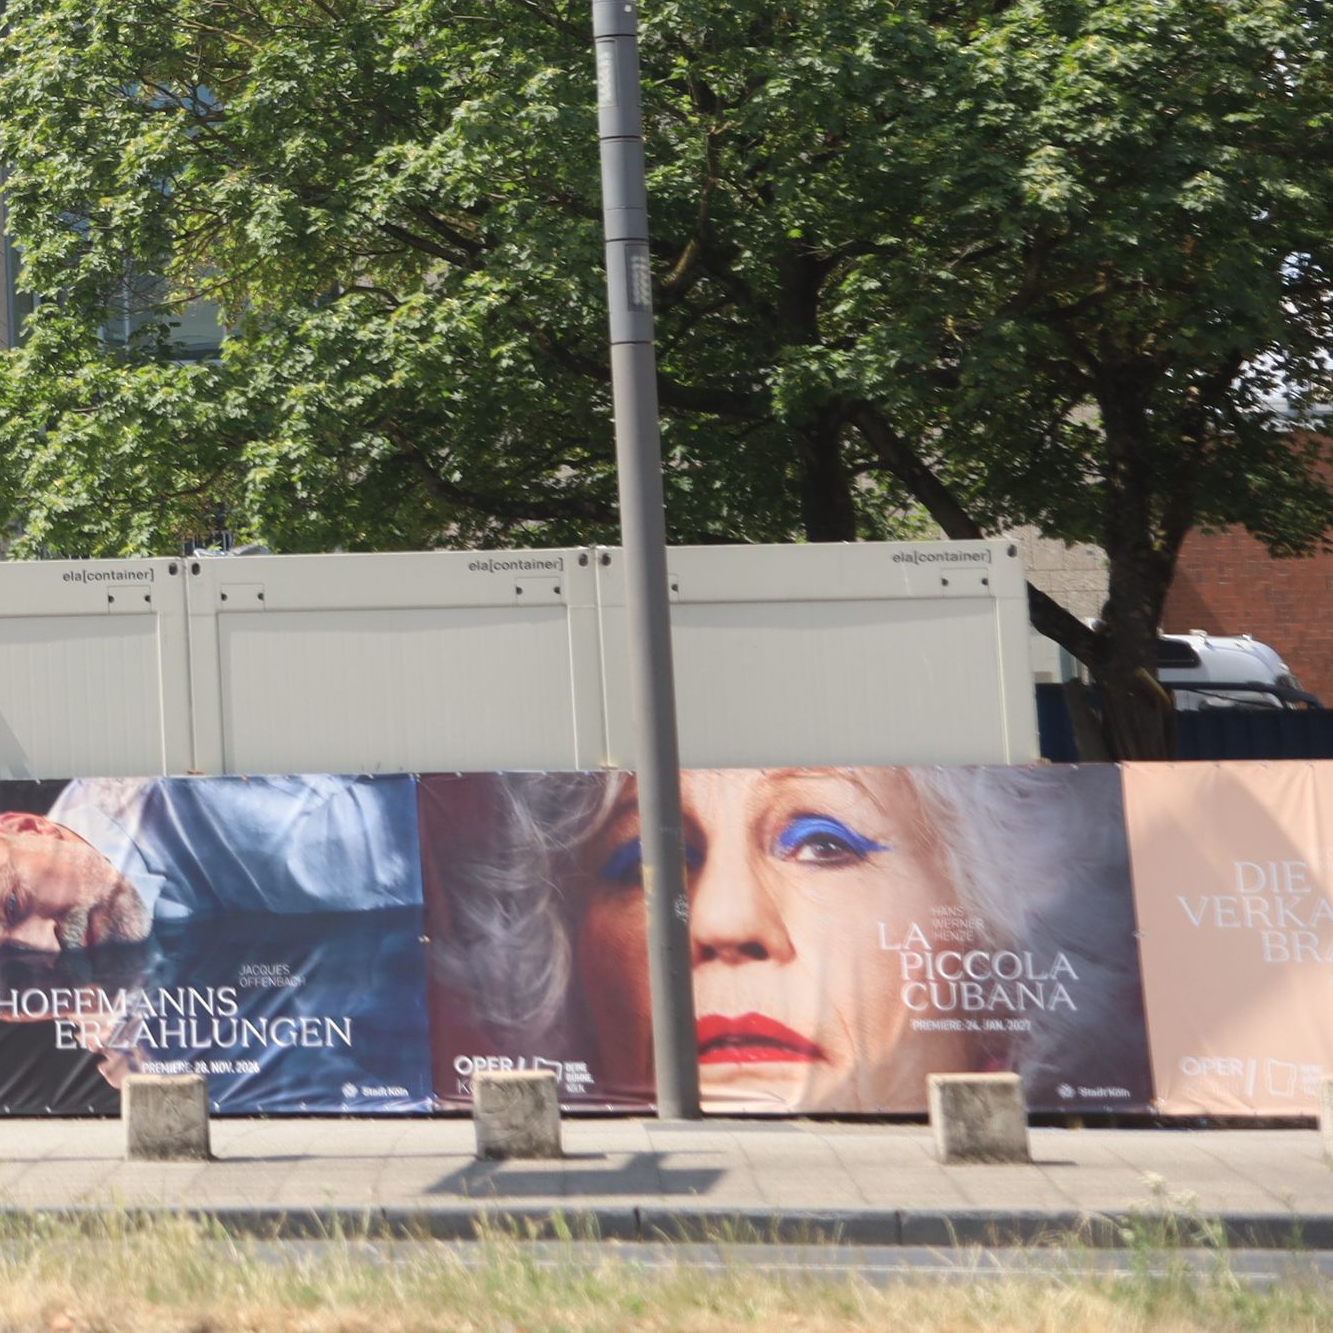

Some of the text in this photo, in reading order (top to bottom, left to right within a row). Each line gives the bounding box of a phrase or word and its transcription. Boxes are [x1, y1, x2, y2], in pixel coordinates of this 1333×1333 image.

[63, 568, 154, 583] ela[container]
[468, 557, 564, 573] ela[container]
[1234, 860, 1312, 894] DIE
[877, 921, 933, 951] LA
[1261, 930, 1333, 963] BR
[238, 963, 291, 976] JACQUES
[900, 950, 1080, 981] PICCOLA
[239, 976, 306, 988] OFFENBACH
[900, 981, 1078, 1012] CUBANA
[55, 1015, 353, 1050] ERZÄHLUNGEN
[453, 1055, 513, 1075] OPER
[1179, 1055, 1244, 1076] OPER
